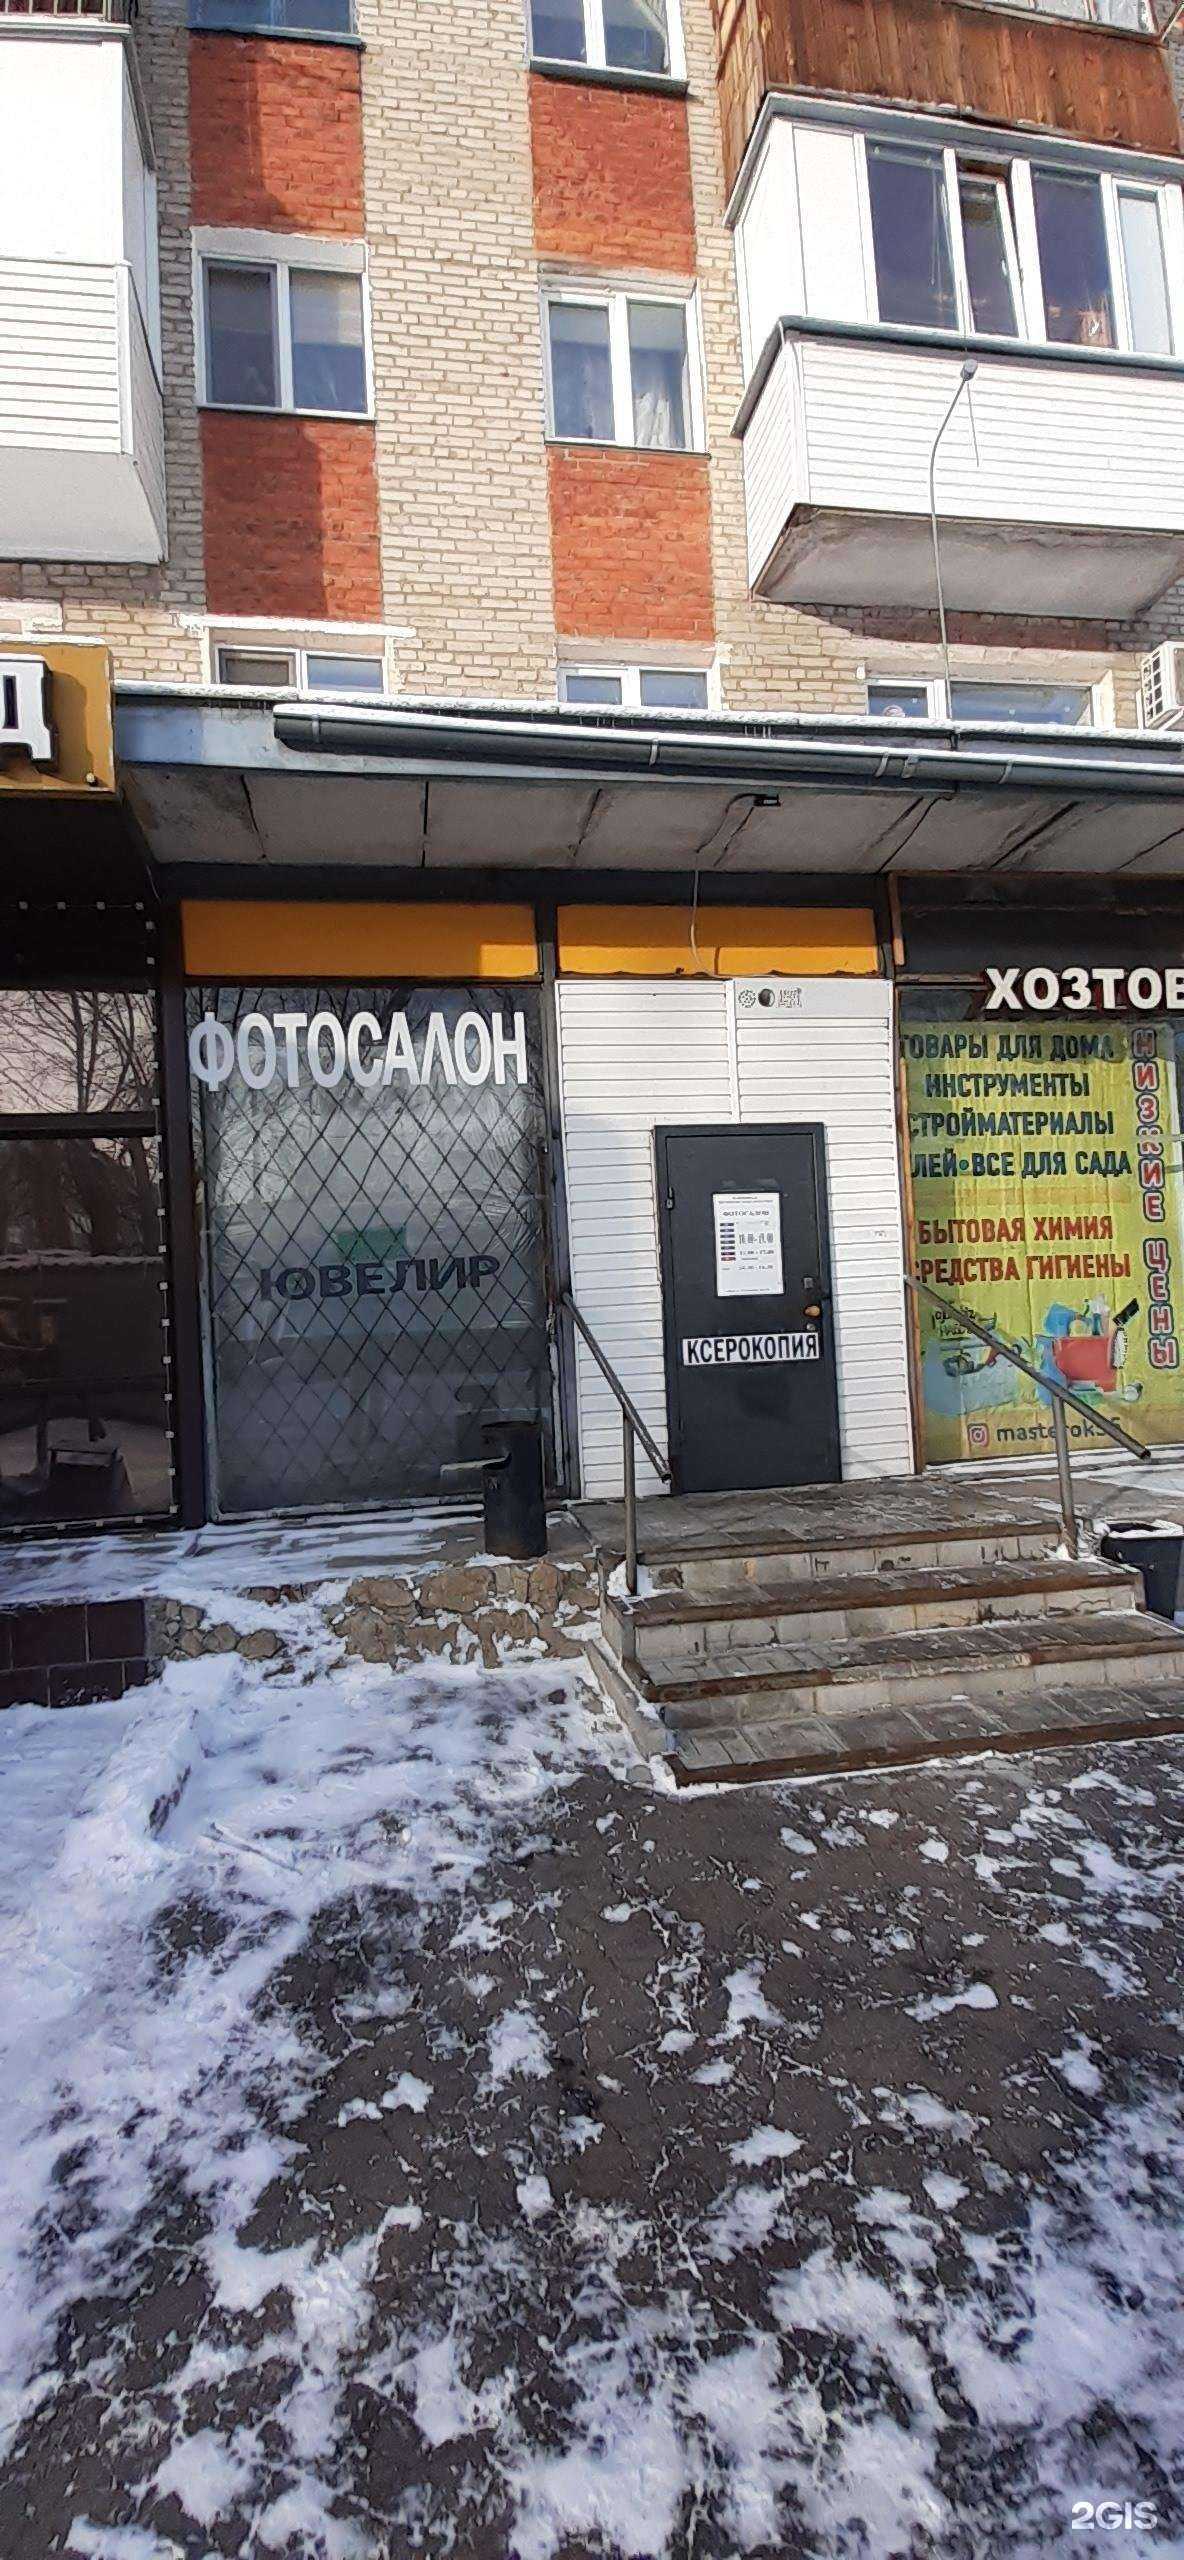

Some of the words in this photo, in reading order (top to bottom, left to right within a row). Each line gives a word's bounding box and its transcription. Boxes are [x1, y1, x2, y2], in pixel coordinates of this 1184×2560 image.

[189, 1011, 528, 1091] ФОТОСАЛОН
[997, 1034, 1042, 1061] ДЛЯ
[1051, 1033, 1115, 1060] ДОМА
[925, 1072, 1090, 1099] ИНСТРУМЕНТЫ
[909, 1107, 1114, 1137] СТРОЙМАТЕРИАЛЫ
[1132, 1028, 1167, 1222] НИЗКИЕ
[971, 1152, 1015, 1177] ВСЕ
[1021, 1152, 1067, 1179] ДЛЯ
[1074, 1150, 1132, 1178] САДА
[918, 1217, 1026, 1244] БЫТОВАЯ
[1033, 1215, 1114, 1241] ХИМИЯ
[259, 1254, 500, 1301] ЮВЕЛИР
[1025, 1253, 1132, 1280] ГИГИЕНЫ
[1143, 1237, 1180, 1369] ЦЕНЫ
[686, 1334, 818, 1364] КСЕРОКОПИЯ
